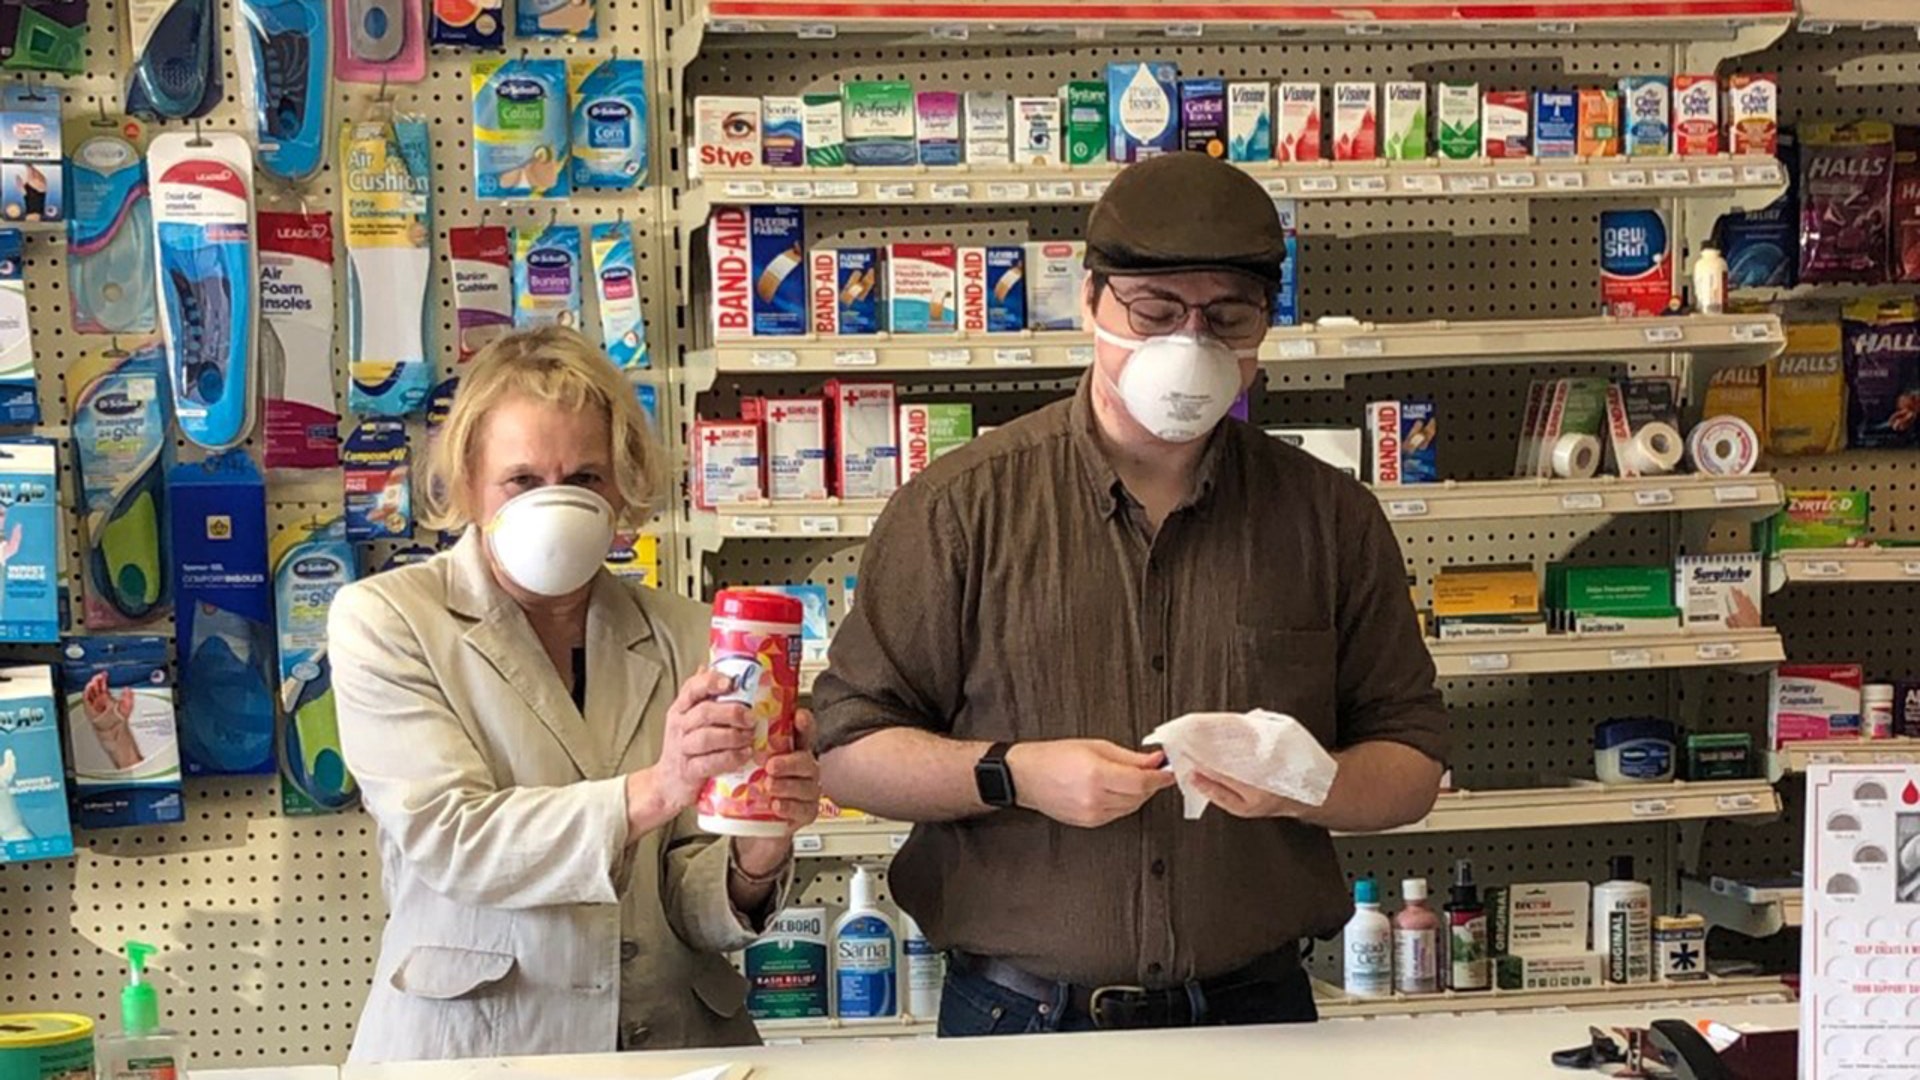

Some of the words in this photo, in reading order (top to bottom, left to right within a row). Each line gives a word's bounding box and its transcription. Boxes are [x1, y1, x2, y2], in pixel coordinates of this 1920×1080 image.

[1069, 88, 1106, 104] Systane
[1232, 87, 1266, 102] Visine
[1282, 86, 1315, 102] Visine
[1337, 85, 1370, 102] Visine
[1388, 85, 1423, 101] Visine
[1740, 93, 1769, 106] Clear
[1635, 96, 1661, 107] Clear
[1682, 94, 1710, 107] Clear
[502, 106, 541, 119] Callus
[766, 105, 800, 116] Soothe
[852, 101, 906, 118] Refresh
[1636, 106, 1660, 117] eyes
[1684, 106, 1710, 117] eyes
[1742, 104, 1768, 115] eyes
[594, 125, 625, 138] Corn
[348, 151, 373, 167] Air
[701, 144, 753, 168] Stye
[1809, 157, 1886, 178] HALLS
[348, 169, 430, 191] Cushion
[753, 218, 799, 228] FLEXIBLE
[753, 227, 790, 236] FABRIC
[1605, 226, 1646, 243] new
[261, 267, 282, 279] Air
[717, 206, 748, 328] BAND-AID
[456, 272, 488, 281] Bunion
[530, 275, 569, 287] Bunion
[261, 282, 303, 295] Foam
[457, 282, 498, 292] Cushions
[815, 254, 835, 333] BAND-AID
[964, 251, 984, 330] BAND-AID
[261, 297, 313, 310] Insoles
[1854, 333, 1920, 354] HALL
[1779, 356, 1838, 373] HALLS
[1379, 405, 1399, 483] BAND-AID
[1692, 566, 1752, 583] Surgitube
[1780, 684, 1816, 694] Allergy
[1780, 695, 1824, 705] Capsules
[839, 941, 886, 958] Sarna
[1612, 915, 1624, 980] ORIGINAL
[784, 975, 817, 984] RELIEF
